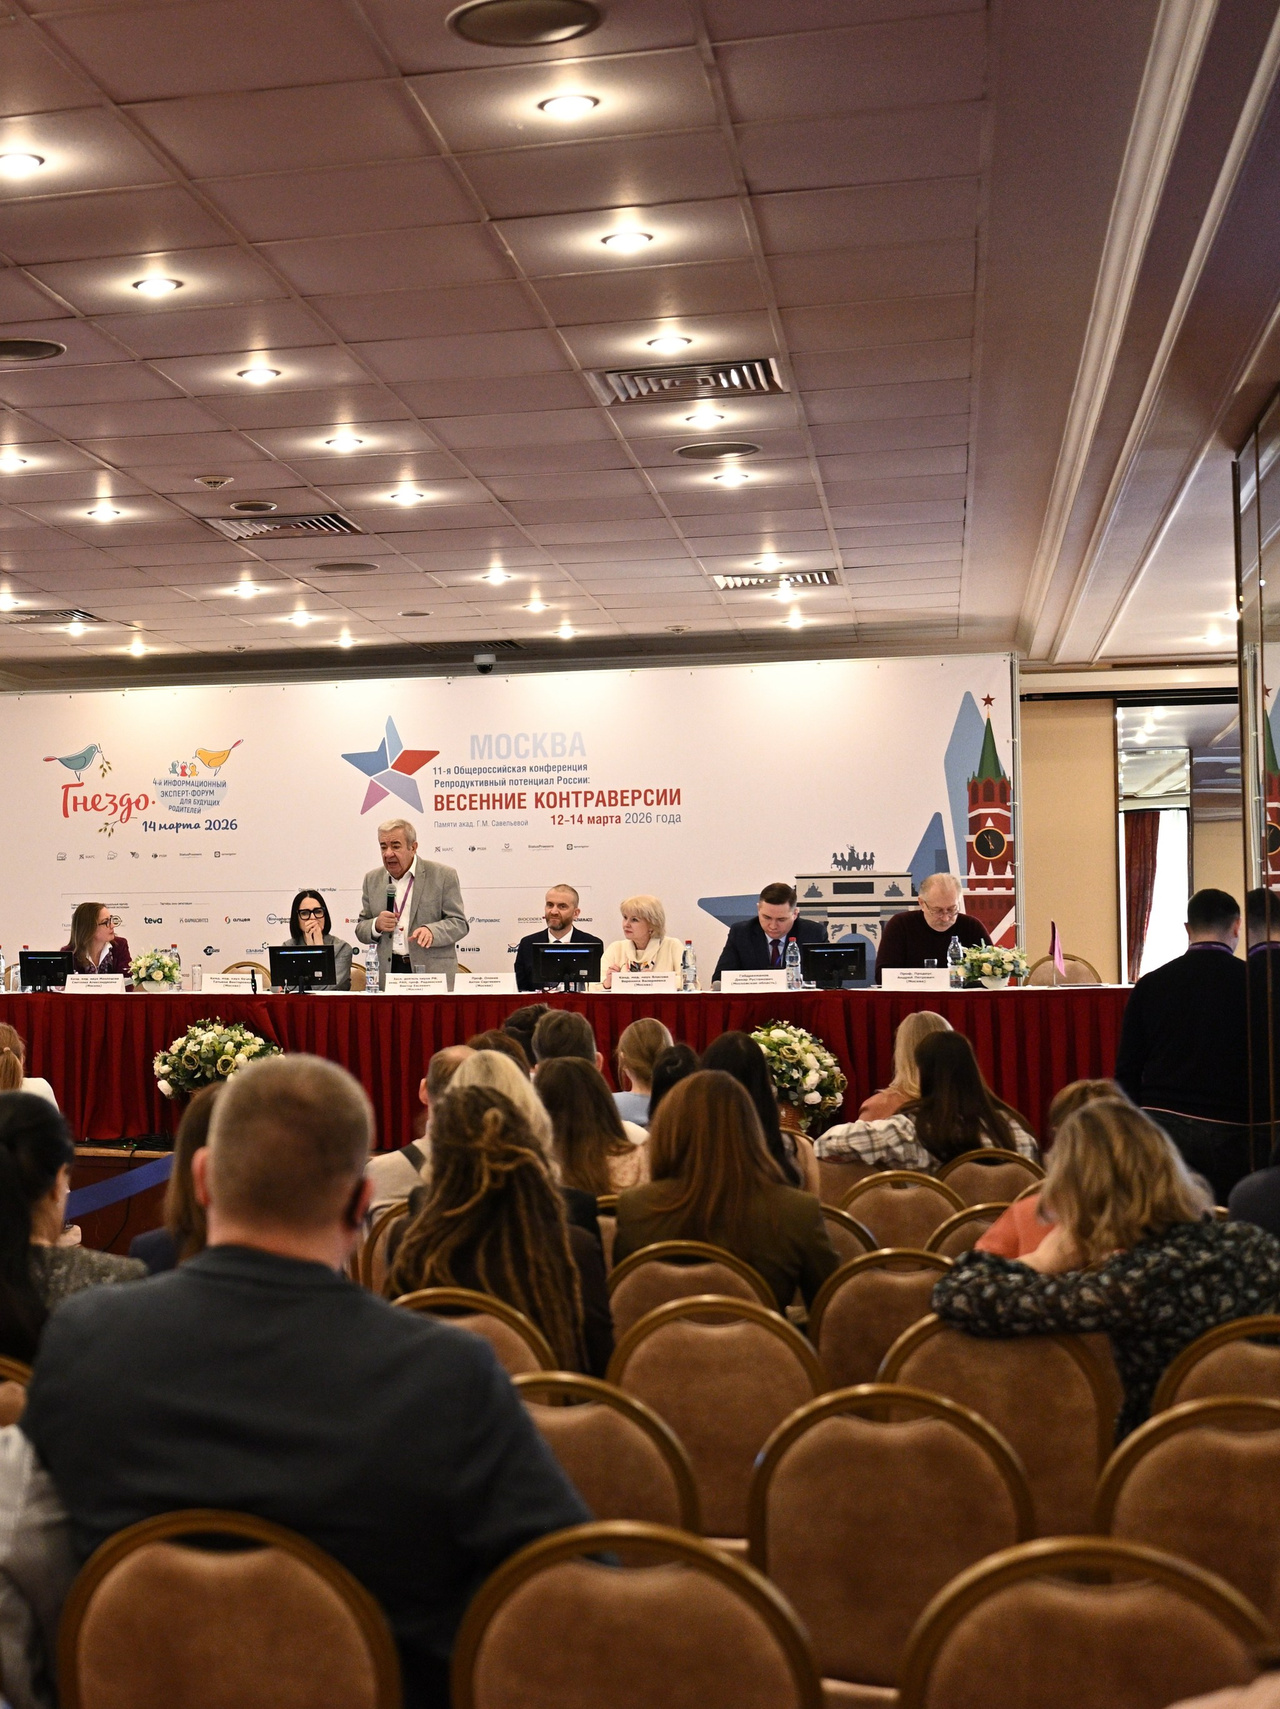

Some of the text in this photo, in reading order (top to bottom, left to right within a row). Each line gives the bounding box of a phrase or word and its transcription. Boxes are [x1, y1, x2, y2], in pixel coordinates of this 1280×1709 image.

[470, 732, 587, 760] МОСКВА
[432, 763, 588, 776] 11-я Общероссийская конференция
[163, 779, 227, 789] ИНФОРМАЦИОННЫЙ
[434, 775, 590, 789] Репродуктивный потенциал России:
[179, 798, 221, 808] ДЛЯ БУДУЩИХ
[433, 788, 682, 812] ВЕСЕННИЕ КОНТРАВЕРСИИ
[168, 804, 202, 814] РОДИТЕЛЕЙ
[142, 818, 238, 834] 14 марта 2026
[434, 820, 458, 829] Памяти
[458, 819, 474, 829] акад.
[491, 818, 529, 828] Савельевой
[587, 814, 621, 827] марта
[624, 812, 652, 824] 2026
[655, 813, 682, 825] года
